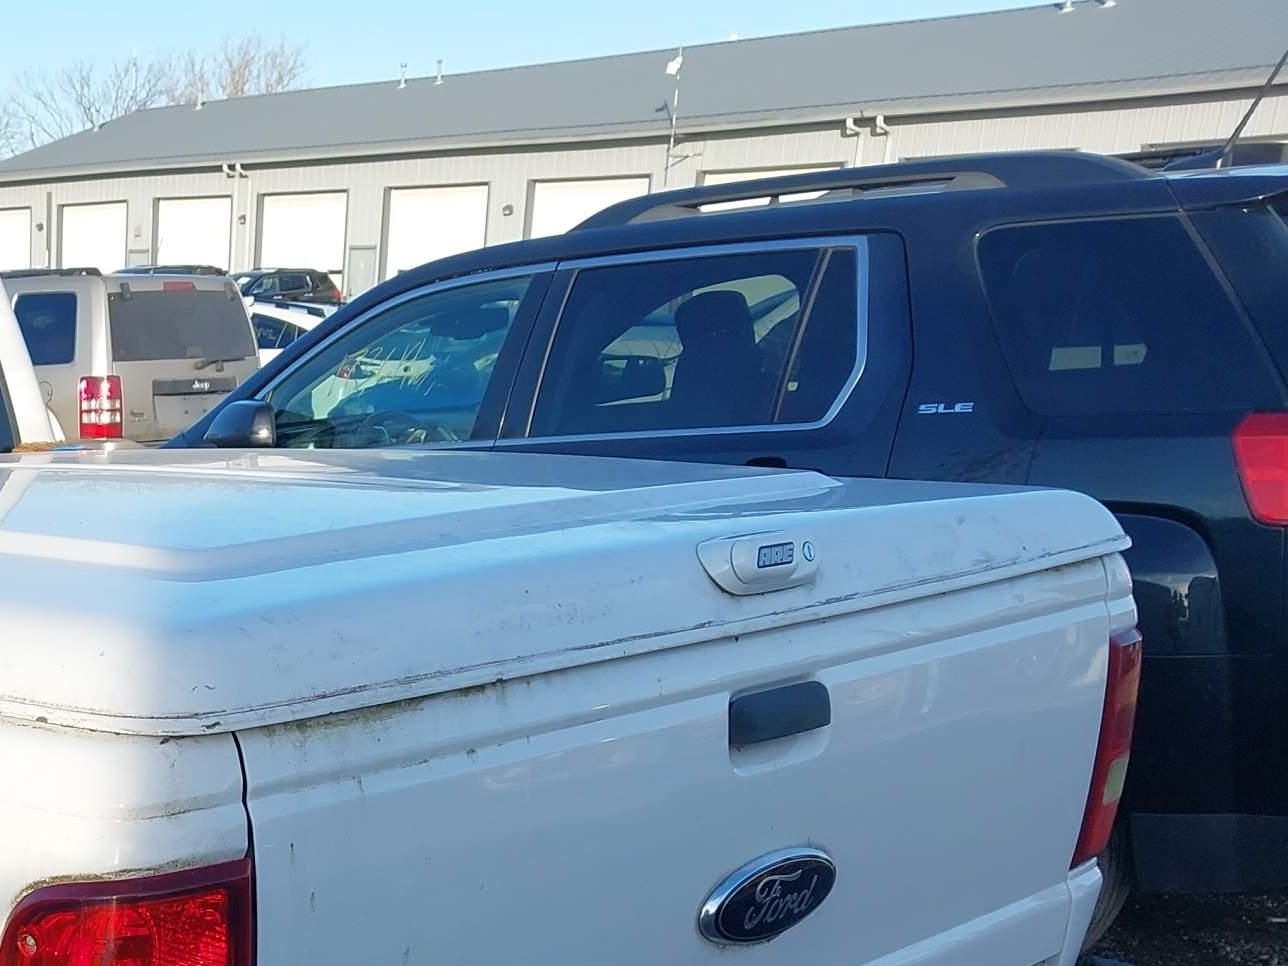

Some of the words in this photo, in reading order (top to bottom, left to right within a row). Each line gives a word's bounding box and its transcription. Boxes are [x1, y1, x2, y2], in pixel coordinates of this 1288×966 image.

[192, 380, 210, 390] Jeep
[918, 402, 974, 414] SLE
[759, 544, 794, 567] ARE
[744, 868, 818, 930] Ford
